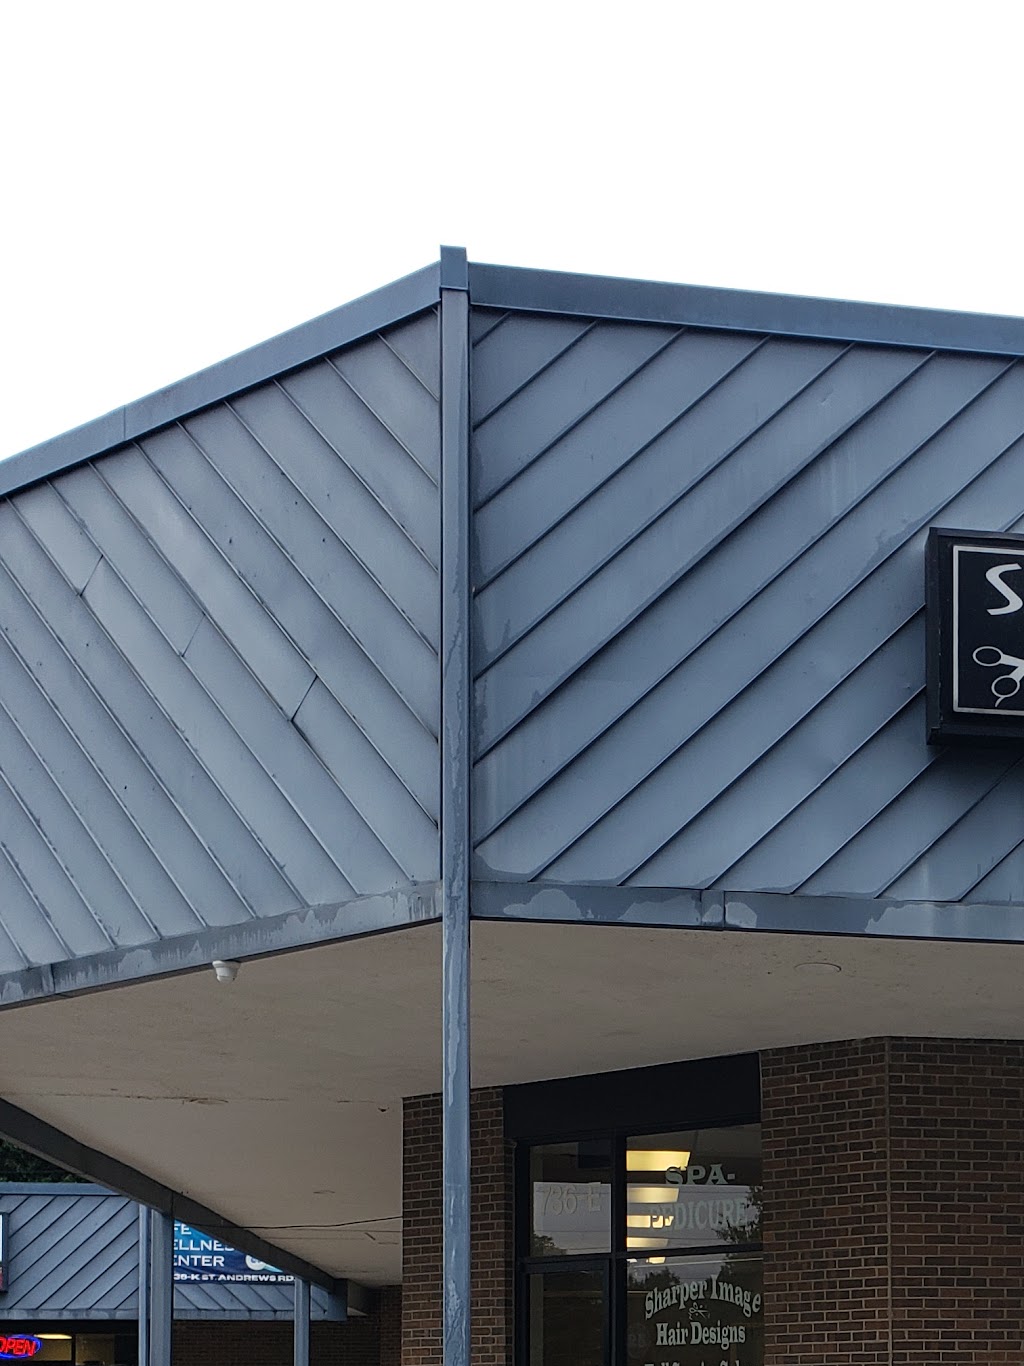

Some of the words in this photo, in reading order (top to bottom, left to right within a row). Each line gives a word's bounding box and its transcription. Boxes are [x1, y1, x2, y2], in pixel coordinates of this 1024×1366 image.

[217, 1274, 276, 1282] ANDREWS
[645, 1280, 707, 1320] Sharper
[710, 1274, 762, 1318] Image
[656, 1321, 688, 1346] Hair
[690, 1319, 746, 1350] Designs
